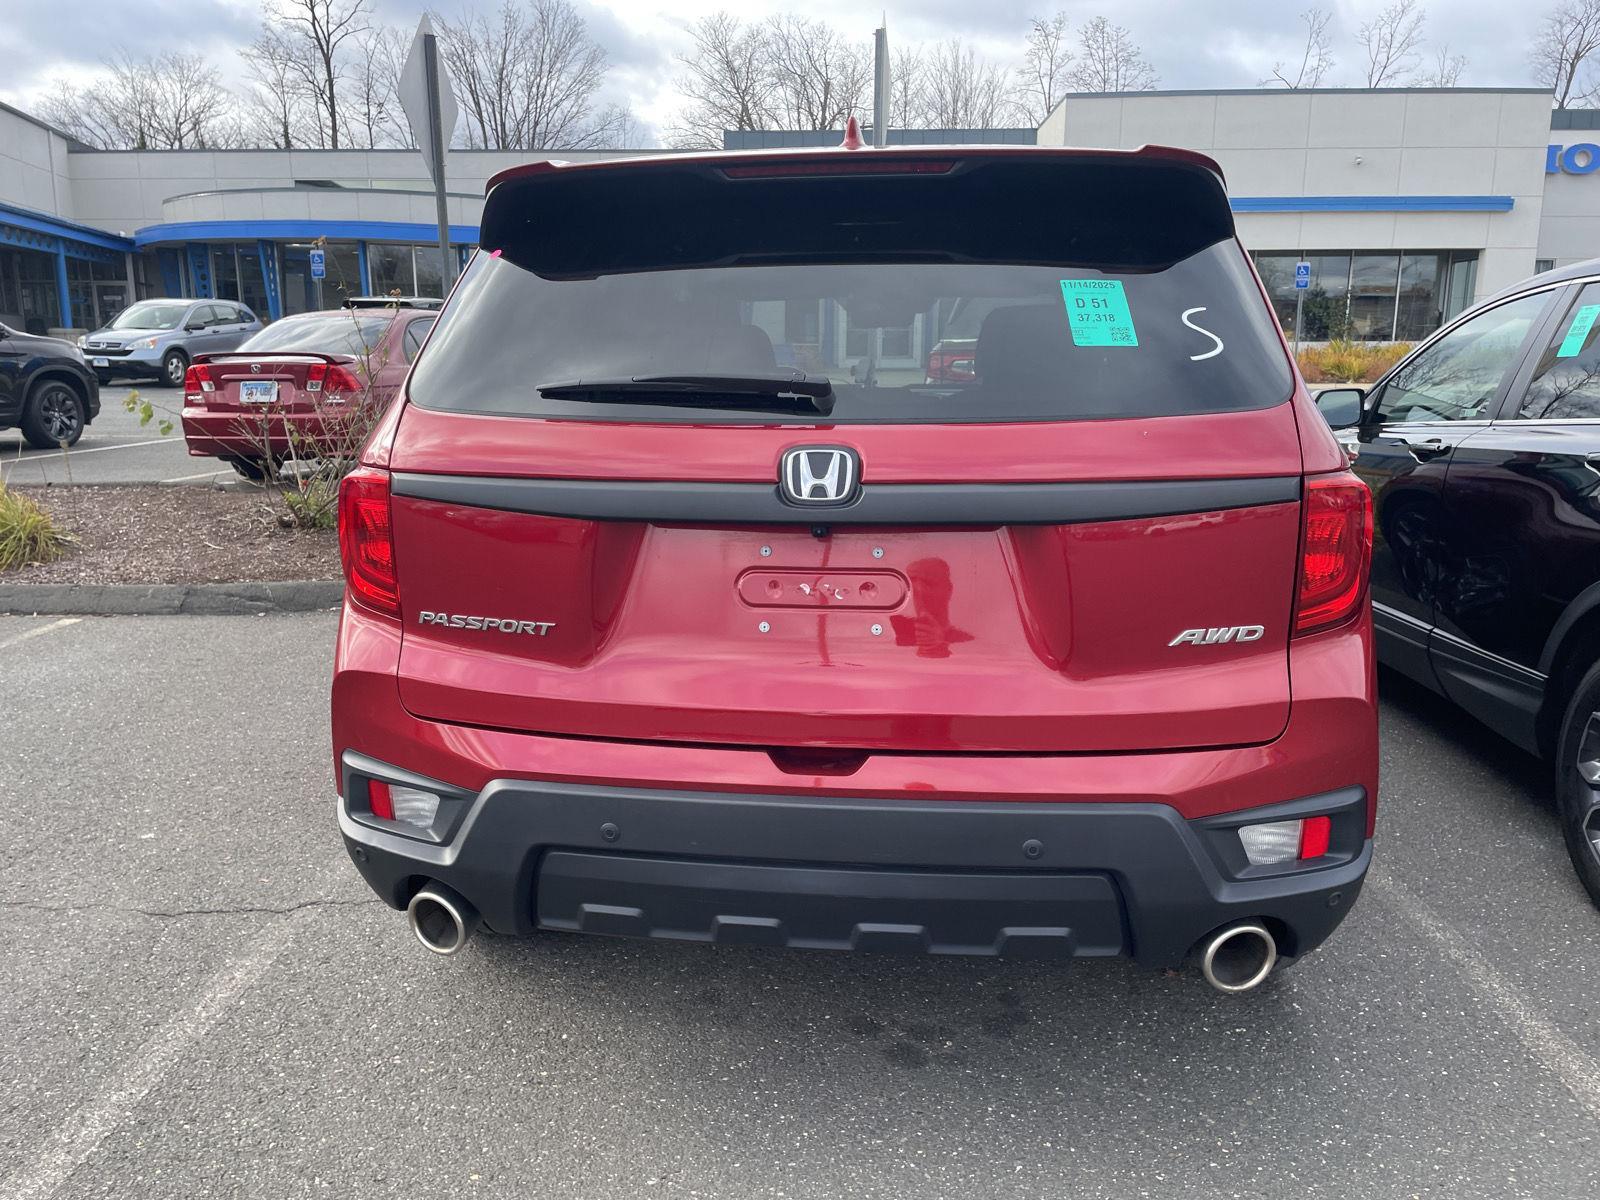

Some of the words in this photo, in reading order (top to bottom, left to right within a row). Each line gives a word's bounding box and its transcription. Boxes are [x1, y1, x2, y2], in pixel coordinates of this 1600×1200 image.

[1062, 281, 1116, 289] 11/14/2025
[1074, 297, 1086, 309] D
[1091, 298, 1109, 309] 51
[1077, 313, 1116, 323] 37,318
[1181, 306, 1224, 361] S
[418, 610, 557, 637] PASSPORT
[1167, 624, 1265, 647] AWD
